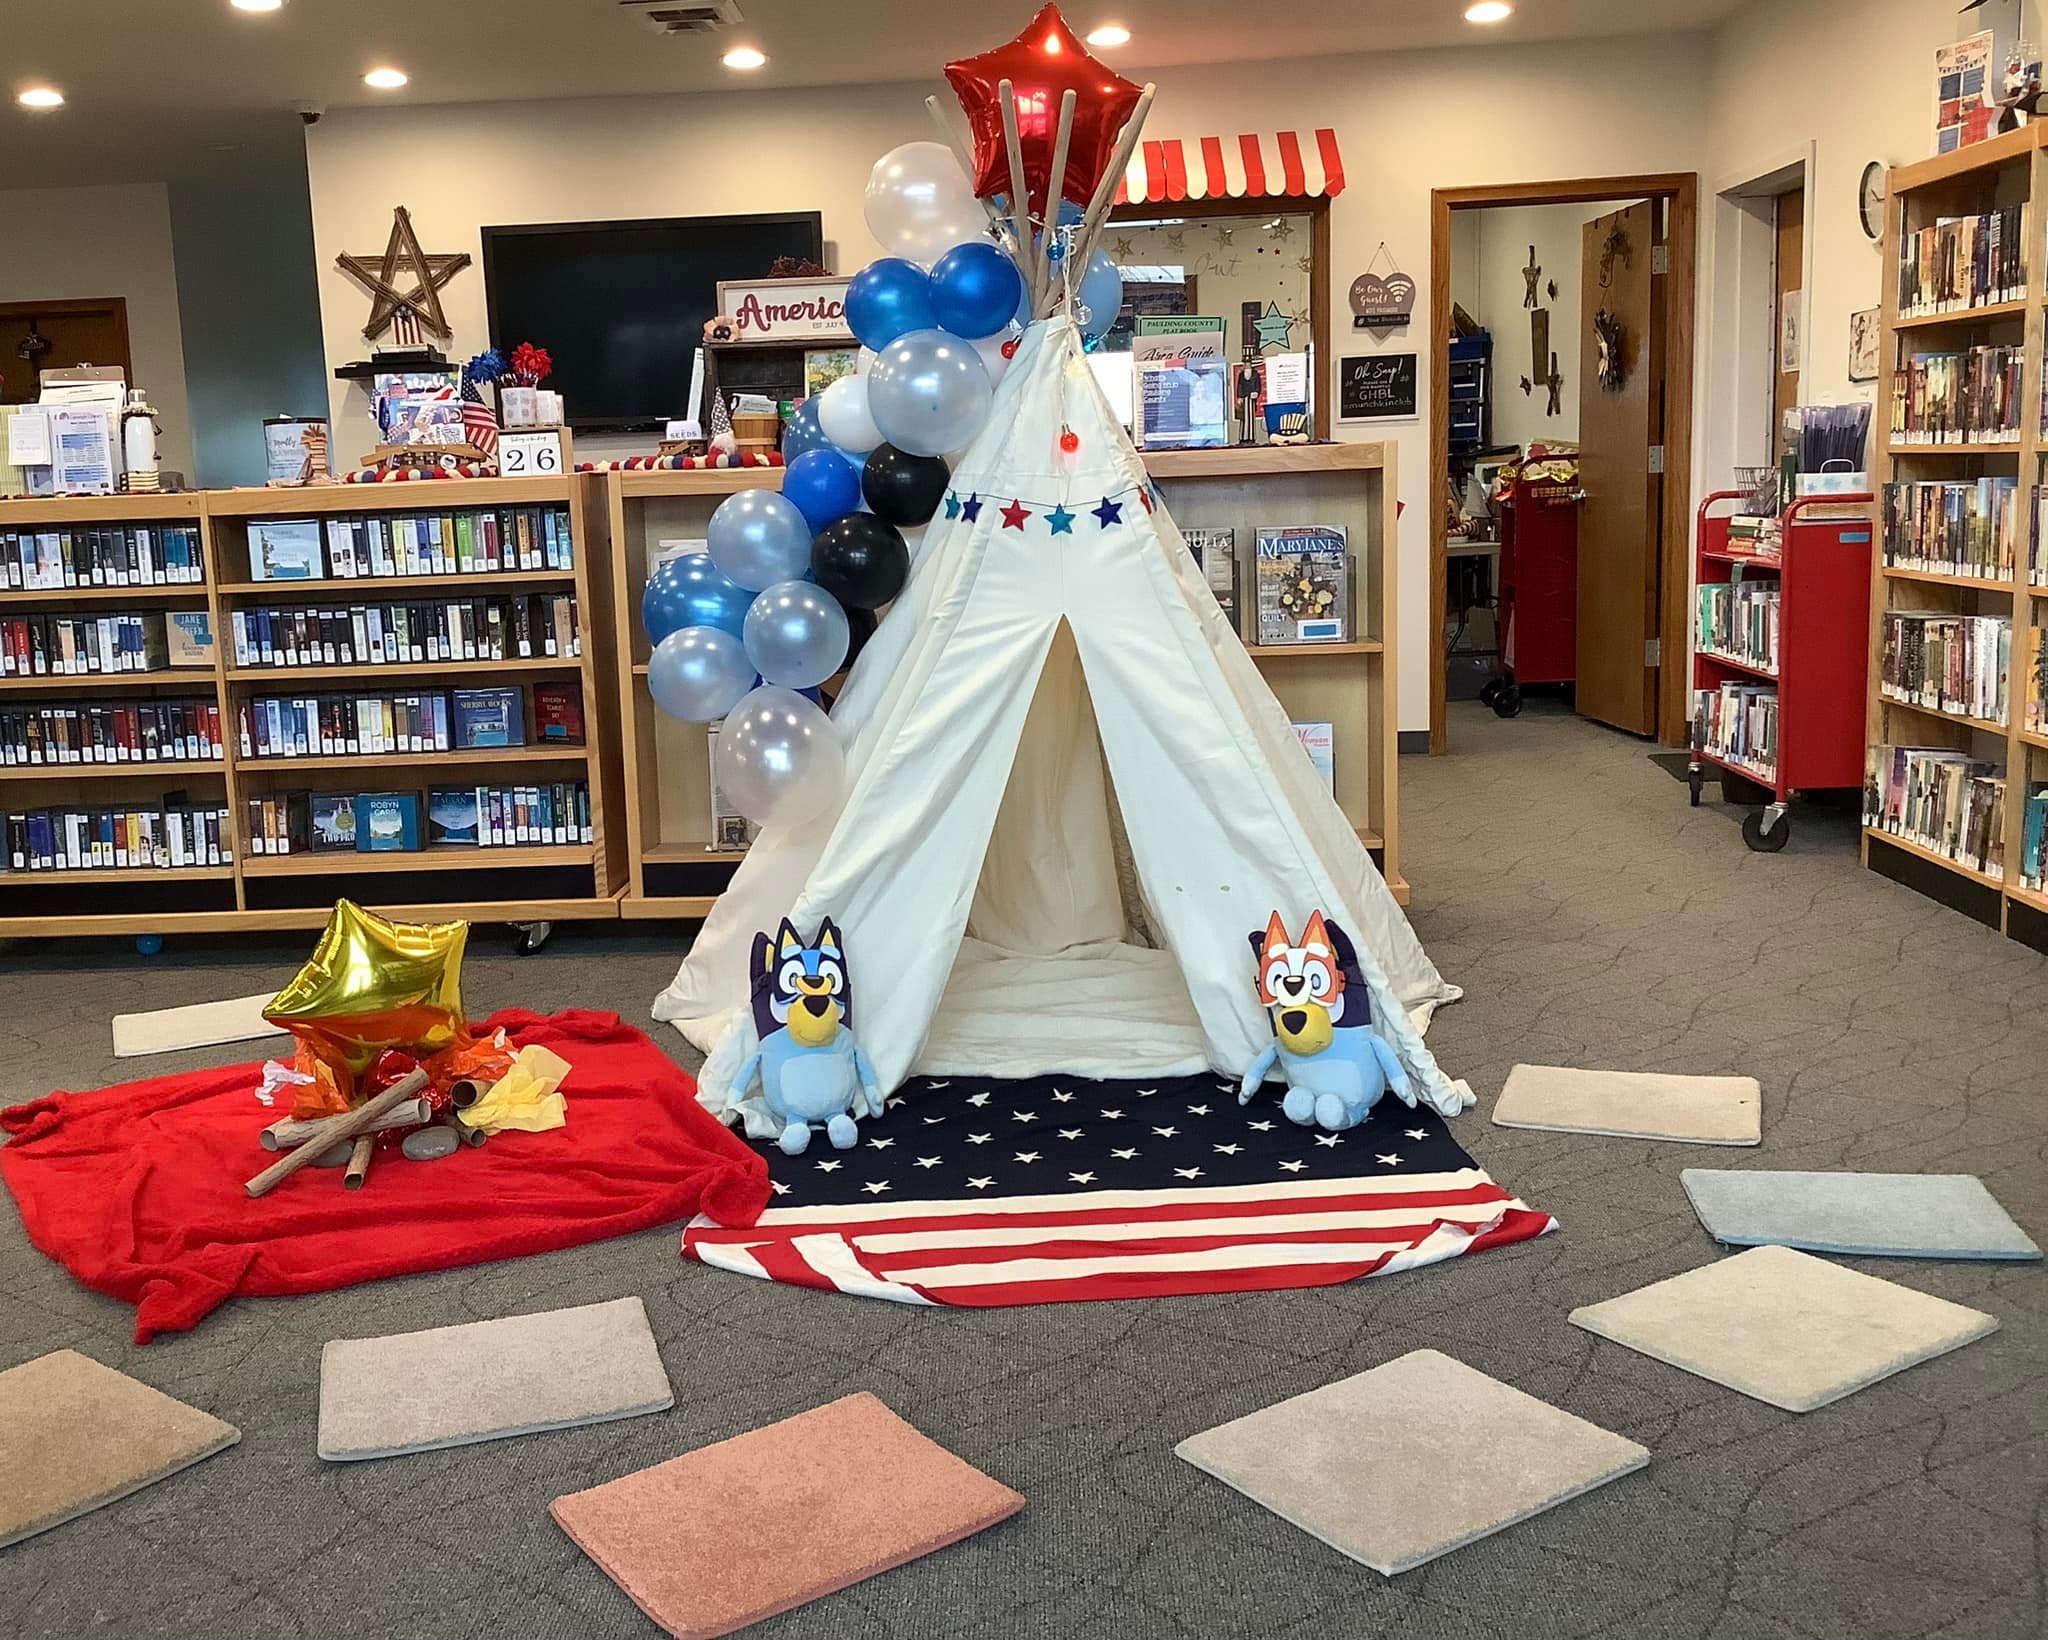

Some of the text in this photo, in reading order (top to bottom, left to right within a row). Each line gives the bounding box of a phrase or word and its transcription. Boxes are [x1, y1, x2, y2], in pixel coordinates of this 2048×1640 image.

[736, 293, 846, 331] Americ
[1147, 320, 1183, 328] PAULDING
[1354, 357, 1403, 384] Oh Snap!
[670, 431, 697, 439] SEEDS
[506, 447, 555, 472] 2 6
[180, 615, 201, 624] JANE
[1261, 614, 1286, 622] QUILT
[371, 801, 399, 809] ROBYN
[374, 809, 397, 817] CARR
